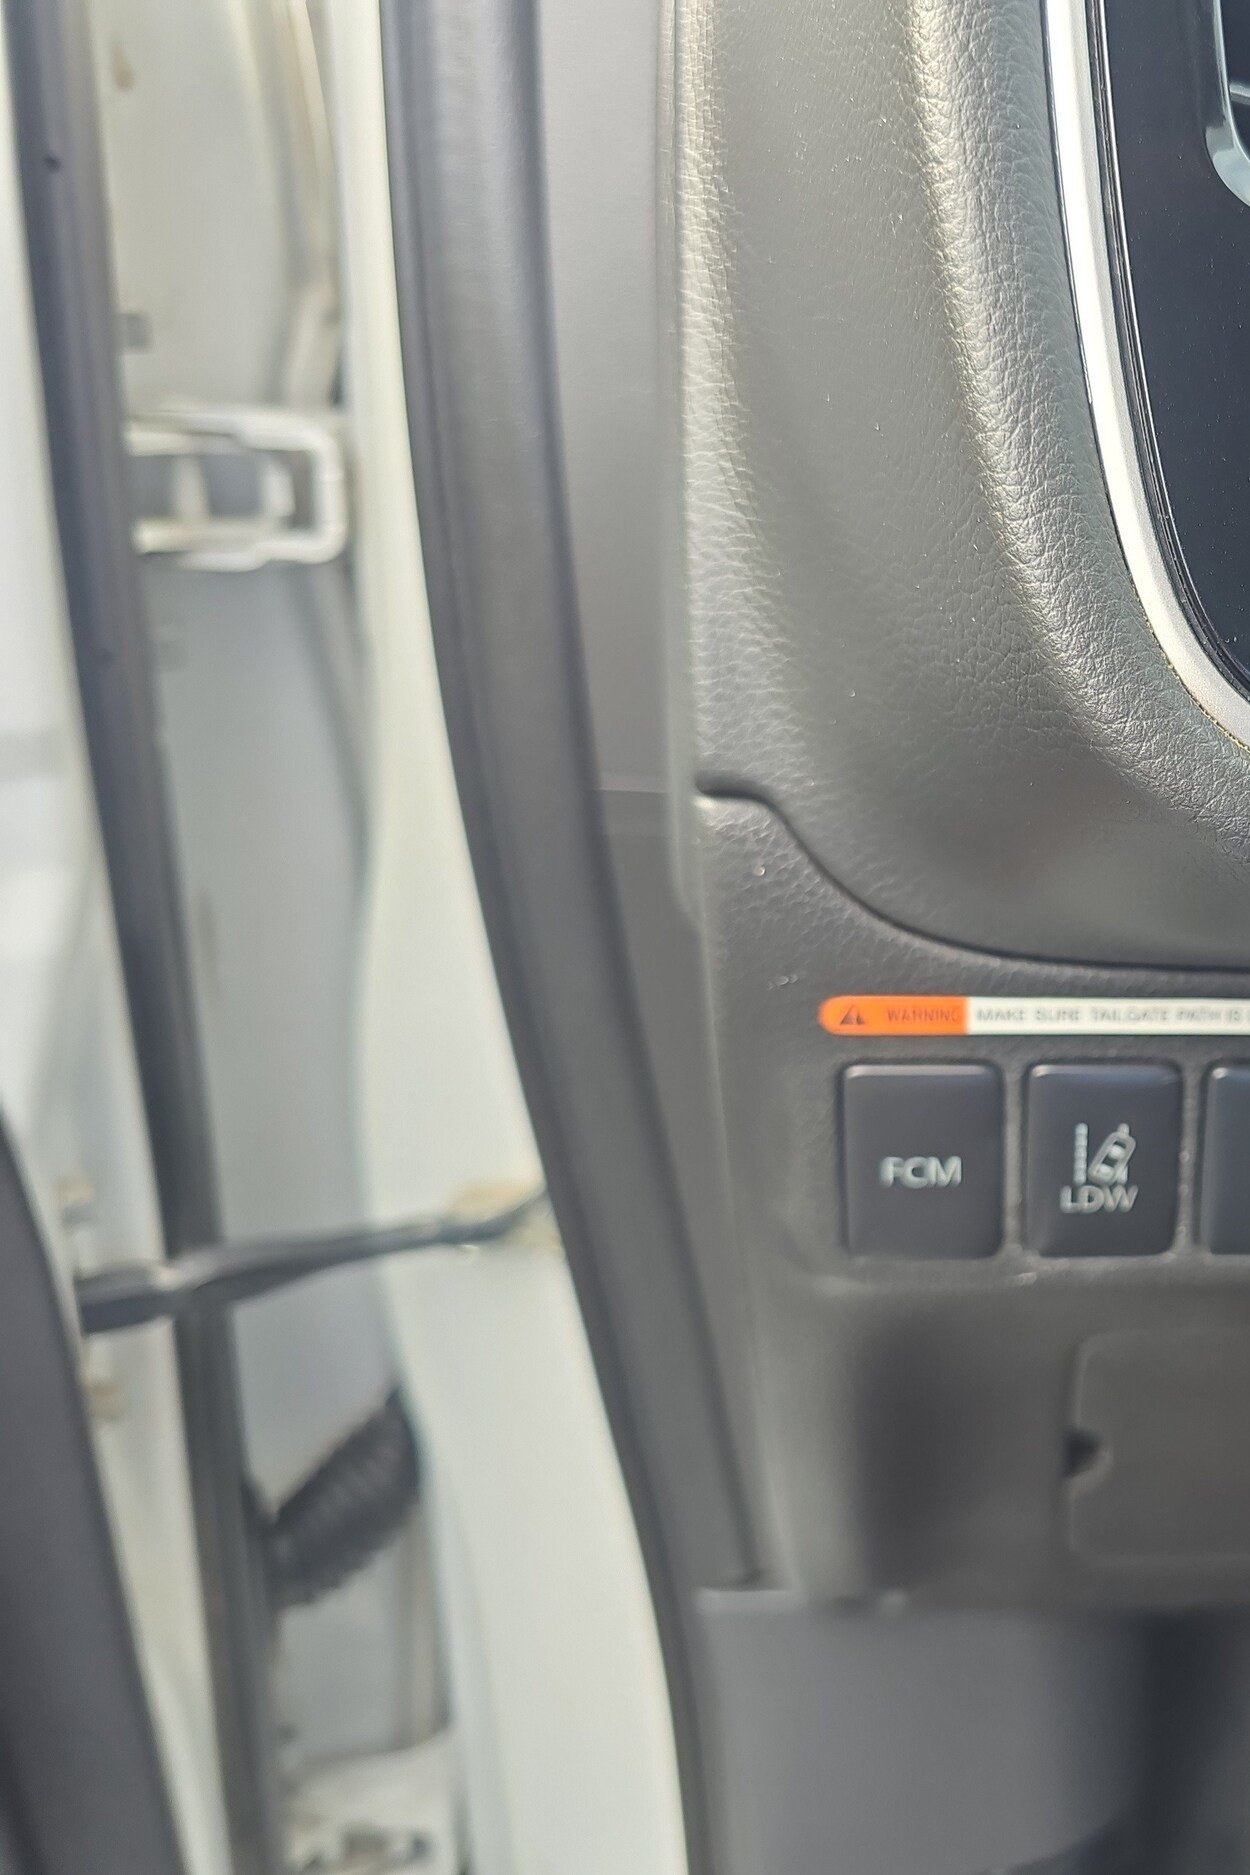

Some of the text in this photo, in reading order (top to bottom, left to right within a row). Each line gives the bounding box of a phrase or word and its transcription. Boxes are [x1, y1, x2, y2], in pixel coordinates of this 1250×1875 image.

[886, 1006, 962, 1023] WARNING
[976, 1006, 1025, 1022] MAKE
[1035, 1006, 1081, 1022] SURE
[1092, 1006, 1168, 1022] TAILGATE
[1176, 1007, 1222, 1022] PATH
[1227, 1007, 1241, 1022] IS
[879, 1156, 963, 1188] FCM
[1059, 1184, 1139, 1214] LDW
